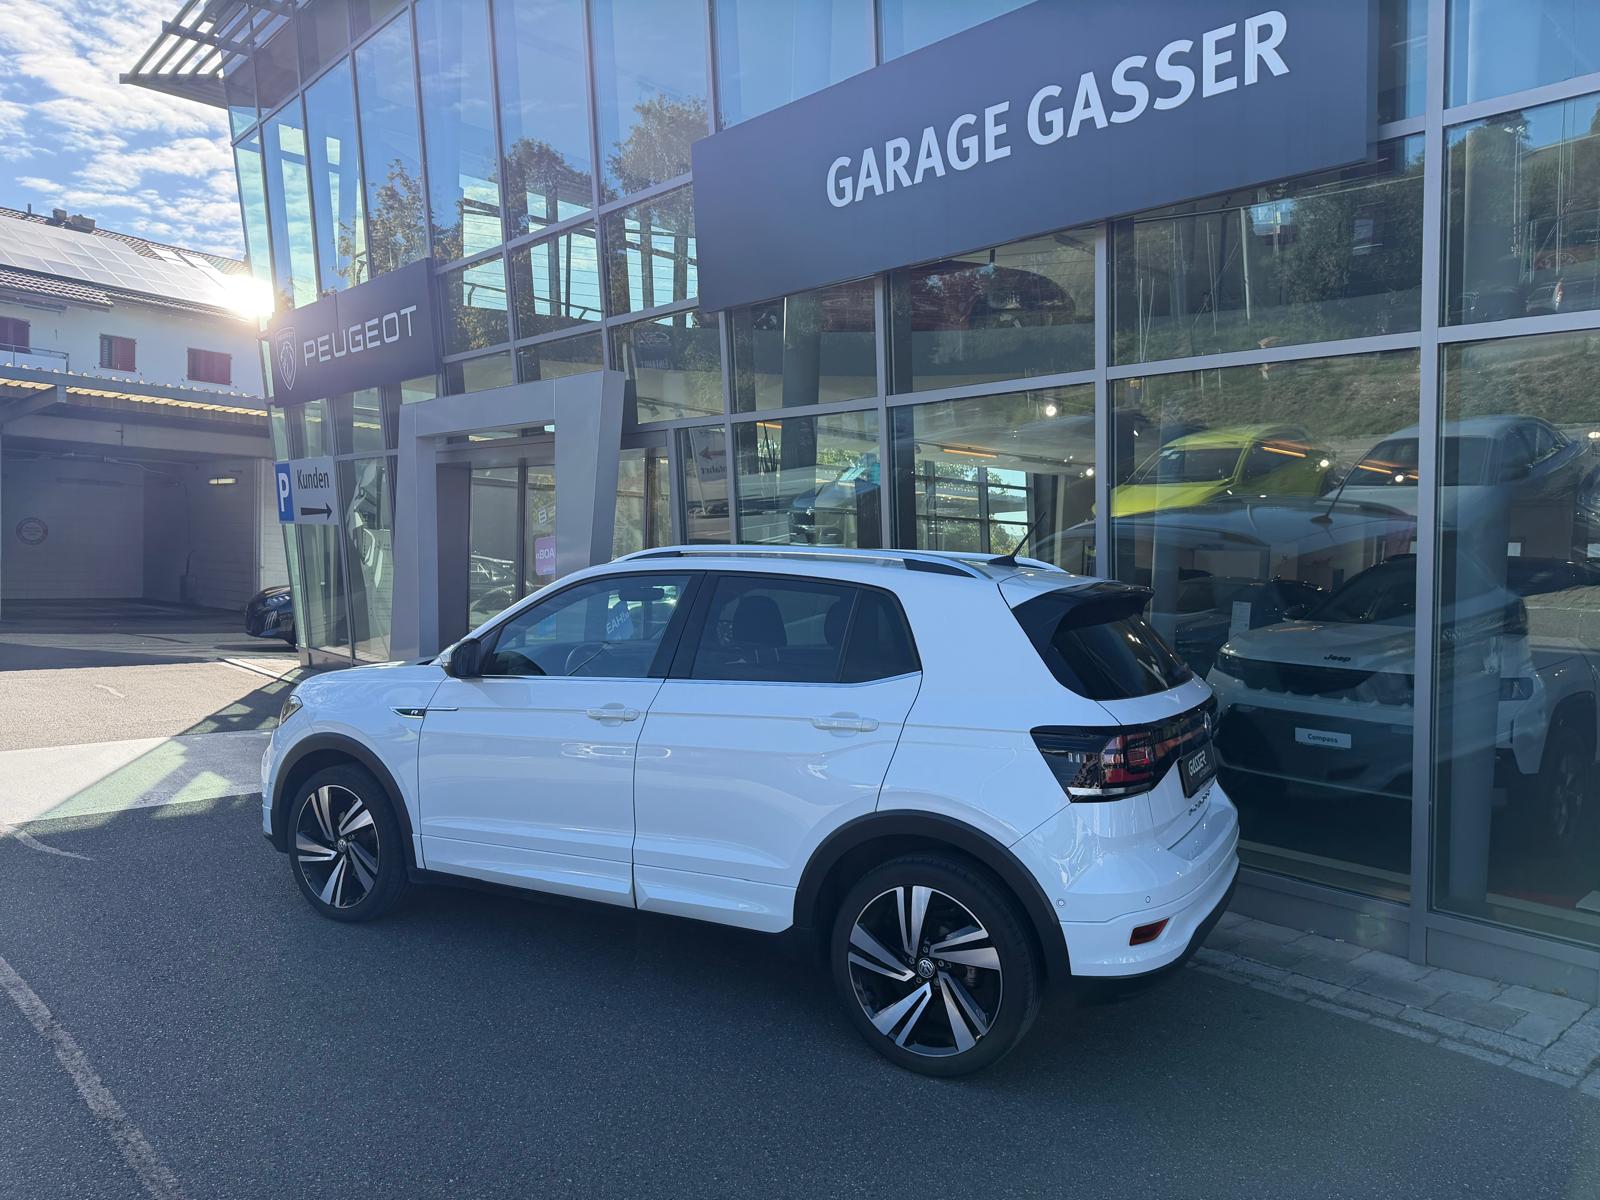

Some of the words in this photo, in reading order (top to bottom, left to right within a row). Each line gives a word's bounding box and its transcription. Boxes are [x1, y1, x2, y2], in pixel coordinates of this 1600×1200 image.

[826, 100, 1011, 208] GARAGE
[1027, 10, 1290, 146] GASSER
[303, 304, 417, 367] PEUGEOT
[278, 472, 290, 513] P
[296, 466, 330, 490] Kunden
[1323, 653, 1352, 664] Jeep
[1307, 733, 1339, 744] Compass
